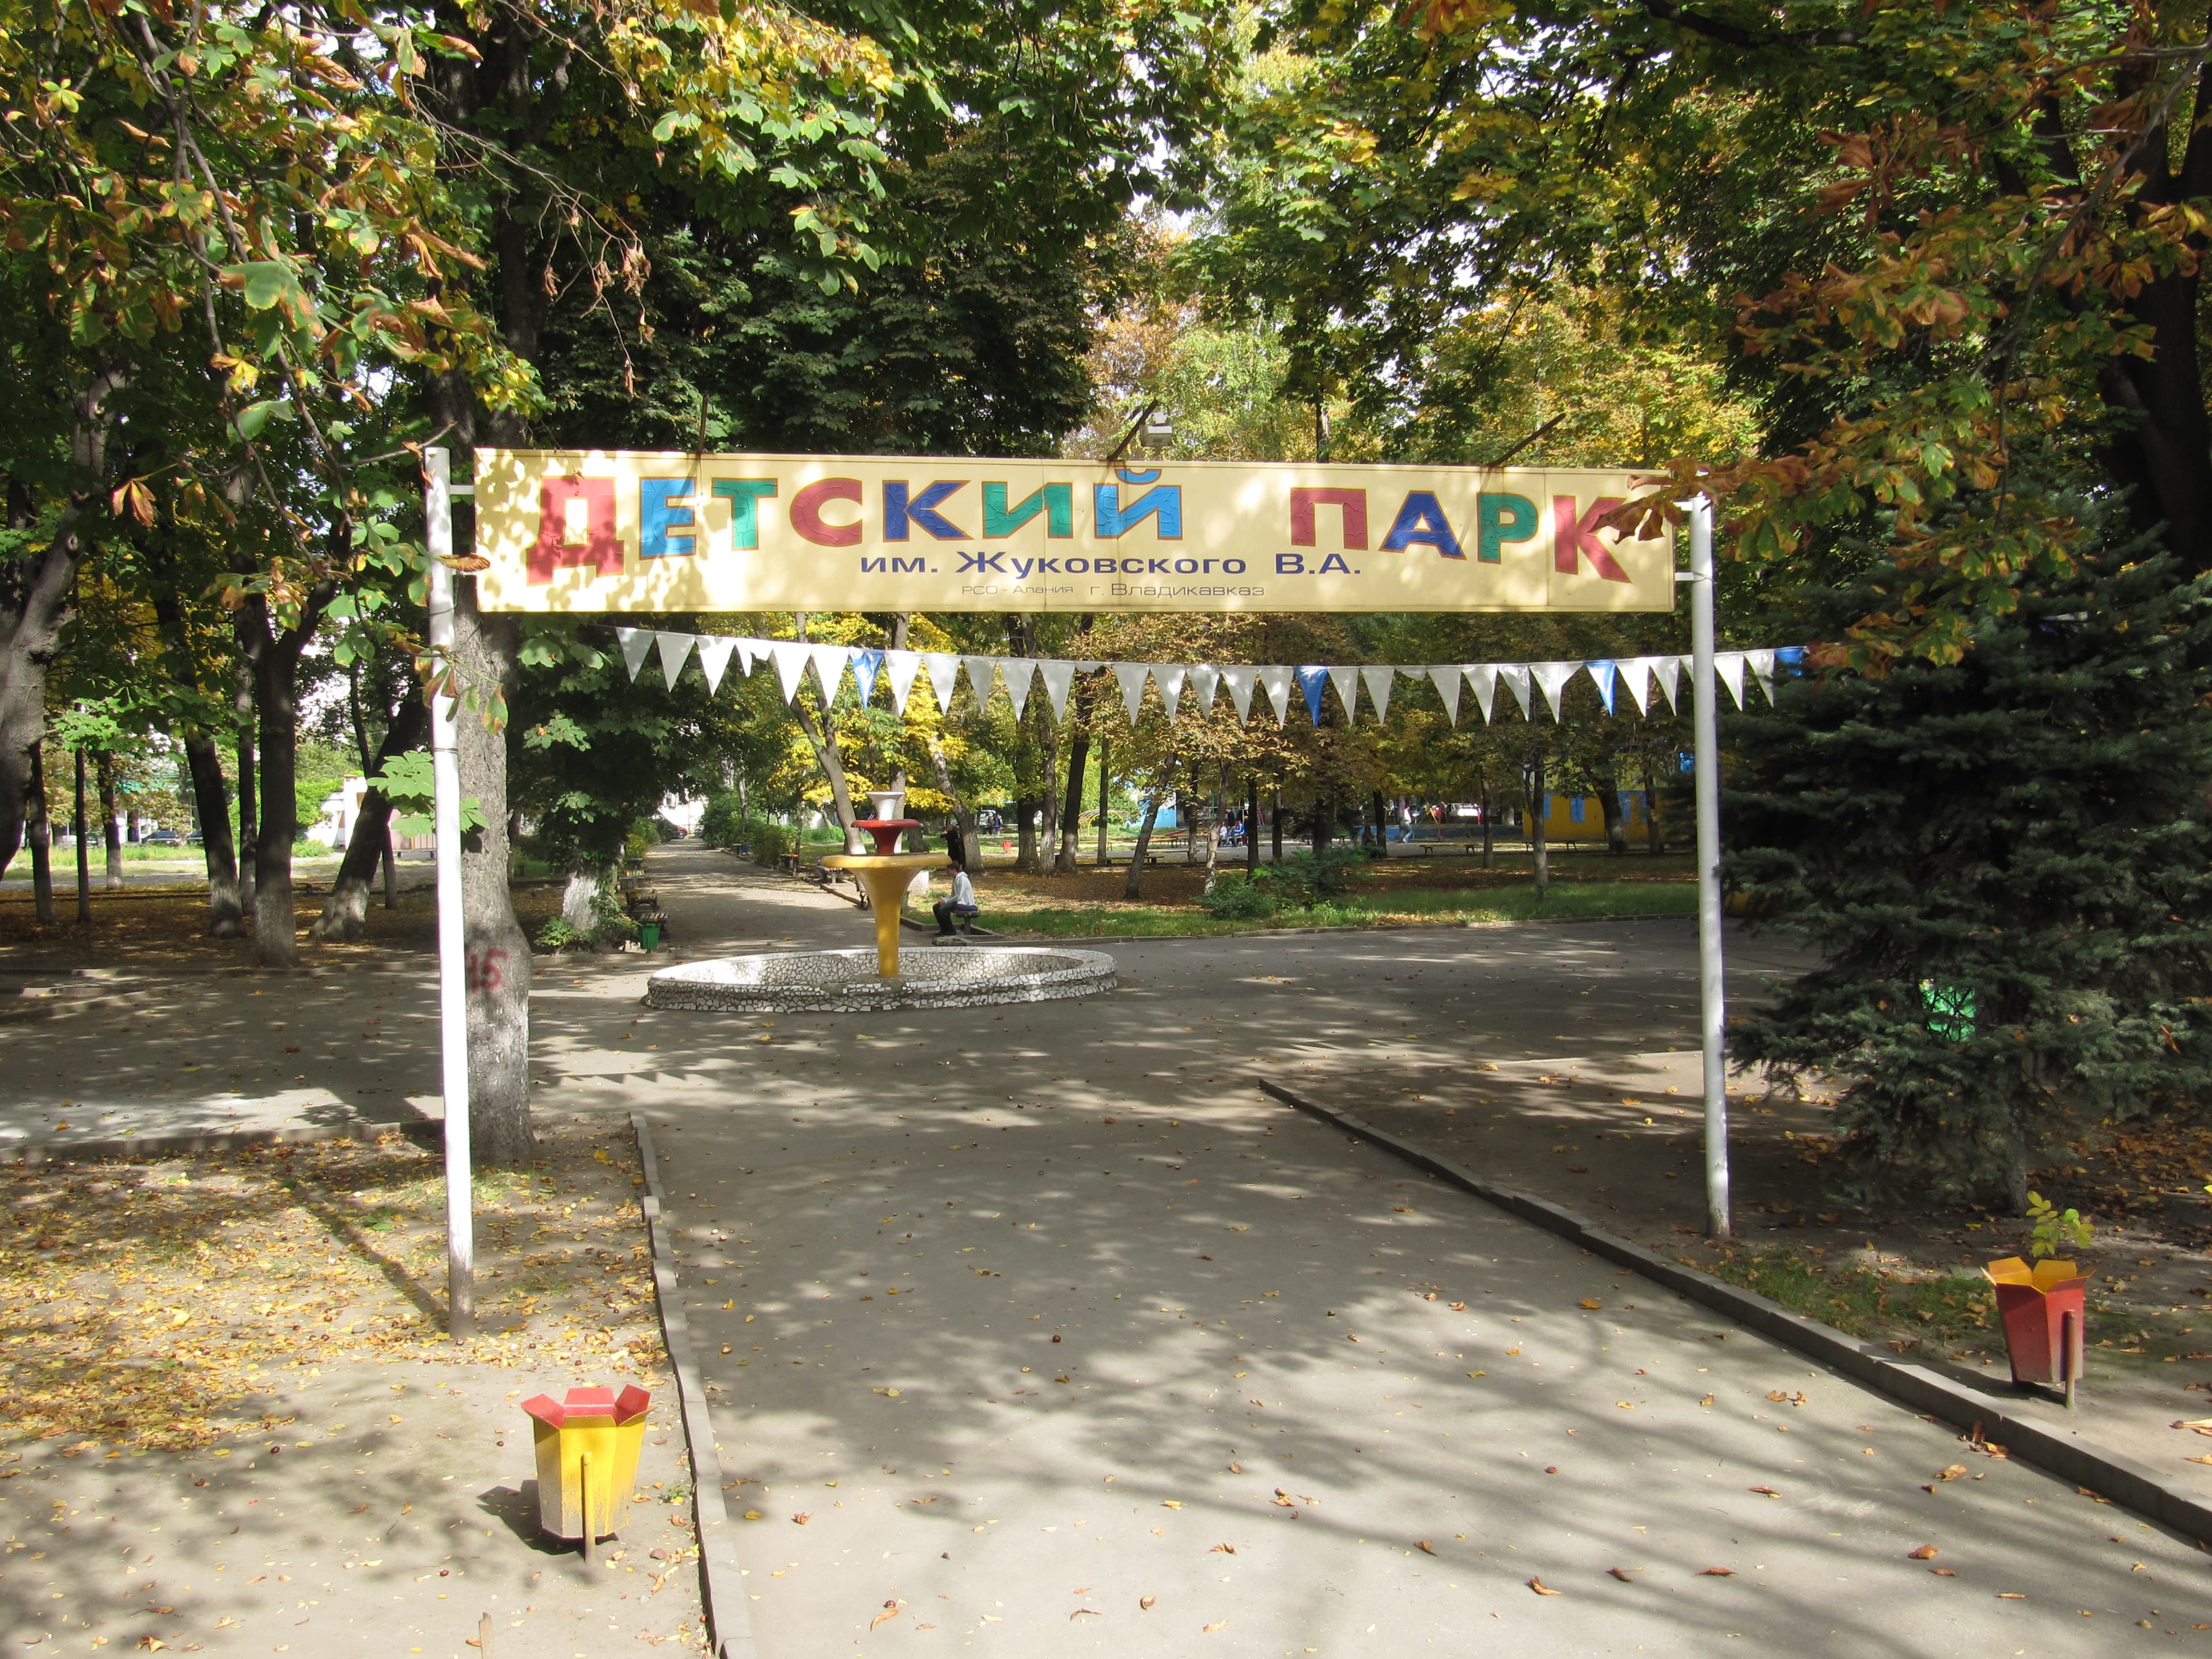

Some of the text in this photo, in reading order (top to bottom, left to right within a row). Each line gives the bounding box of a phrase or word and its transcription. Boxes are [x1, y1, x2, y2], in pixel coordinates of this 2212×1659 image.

[525, 468, 1634, 585] ДЕТСКИЙ ПАРК
[861, 551, 1361, 579] им. Жуковского В.А.
[961, 585, 998, 595] РСО
[1013, 585, 1073, 594] Алания
[1090, 586, 1104, 596] г.
[1111, 583, 1265, 599] Владикавказ
